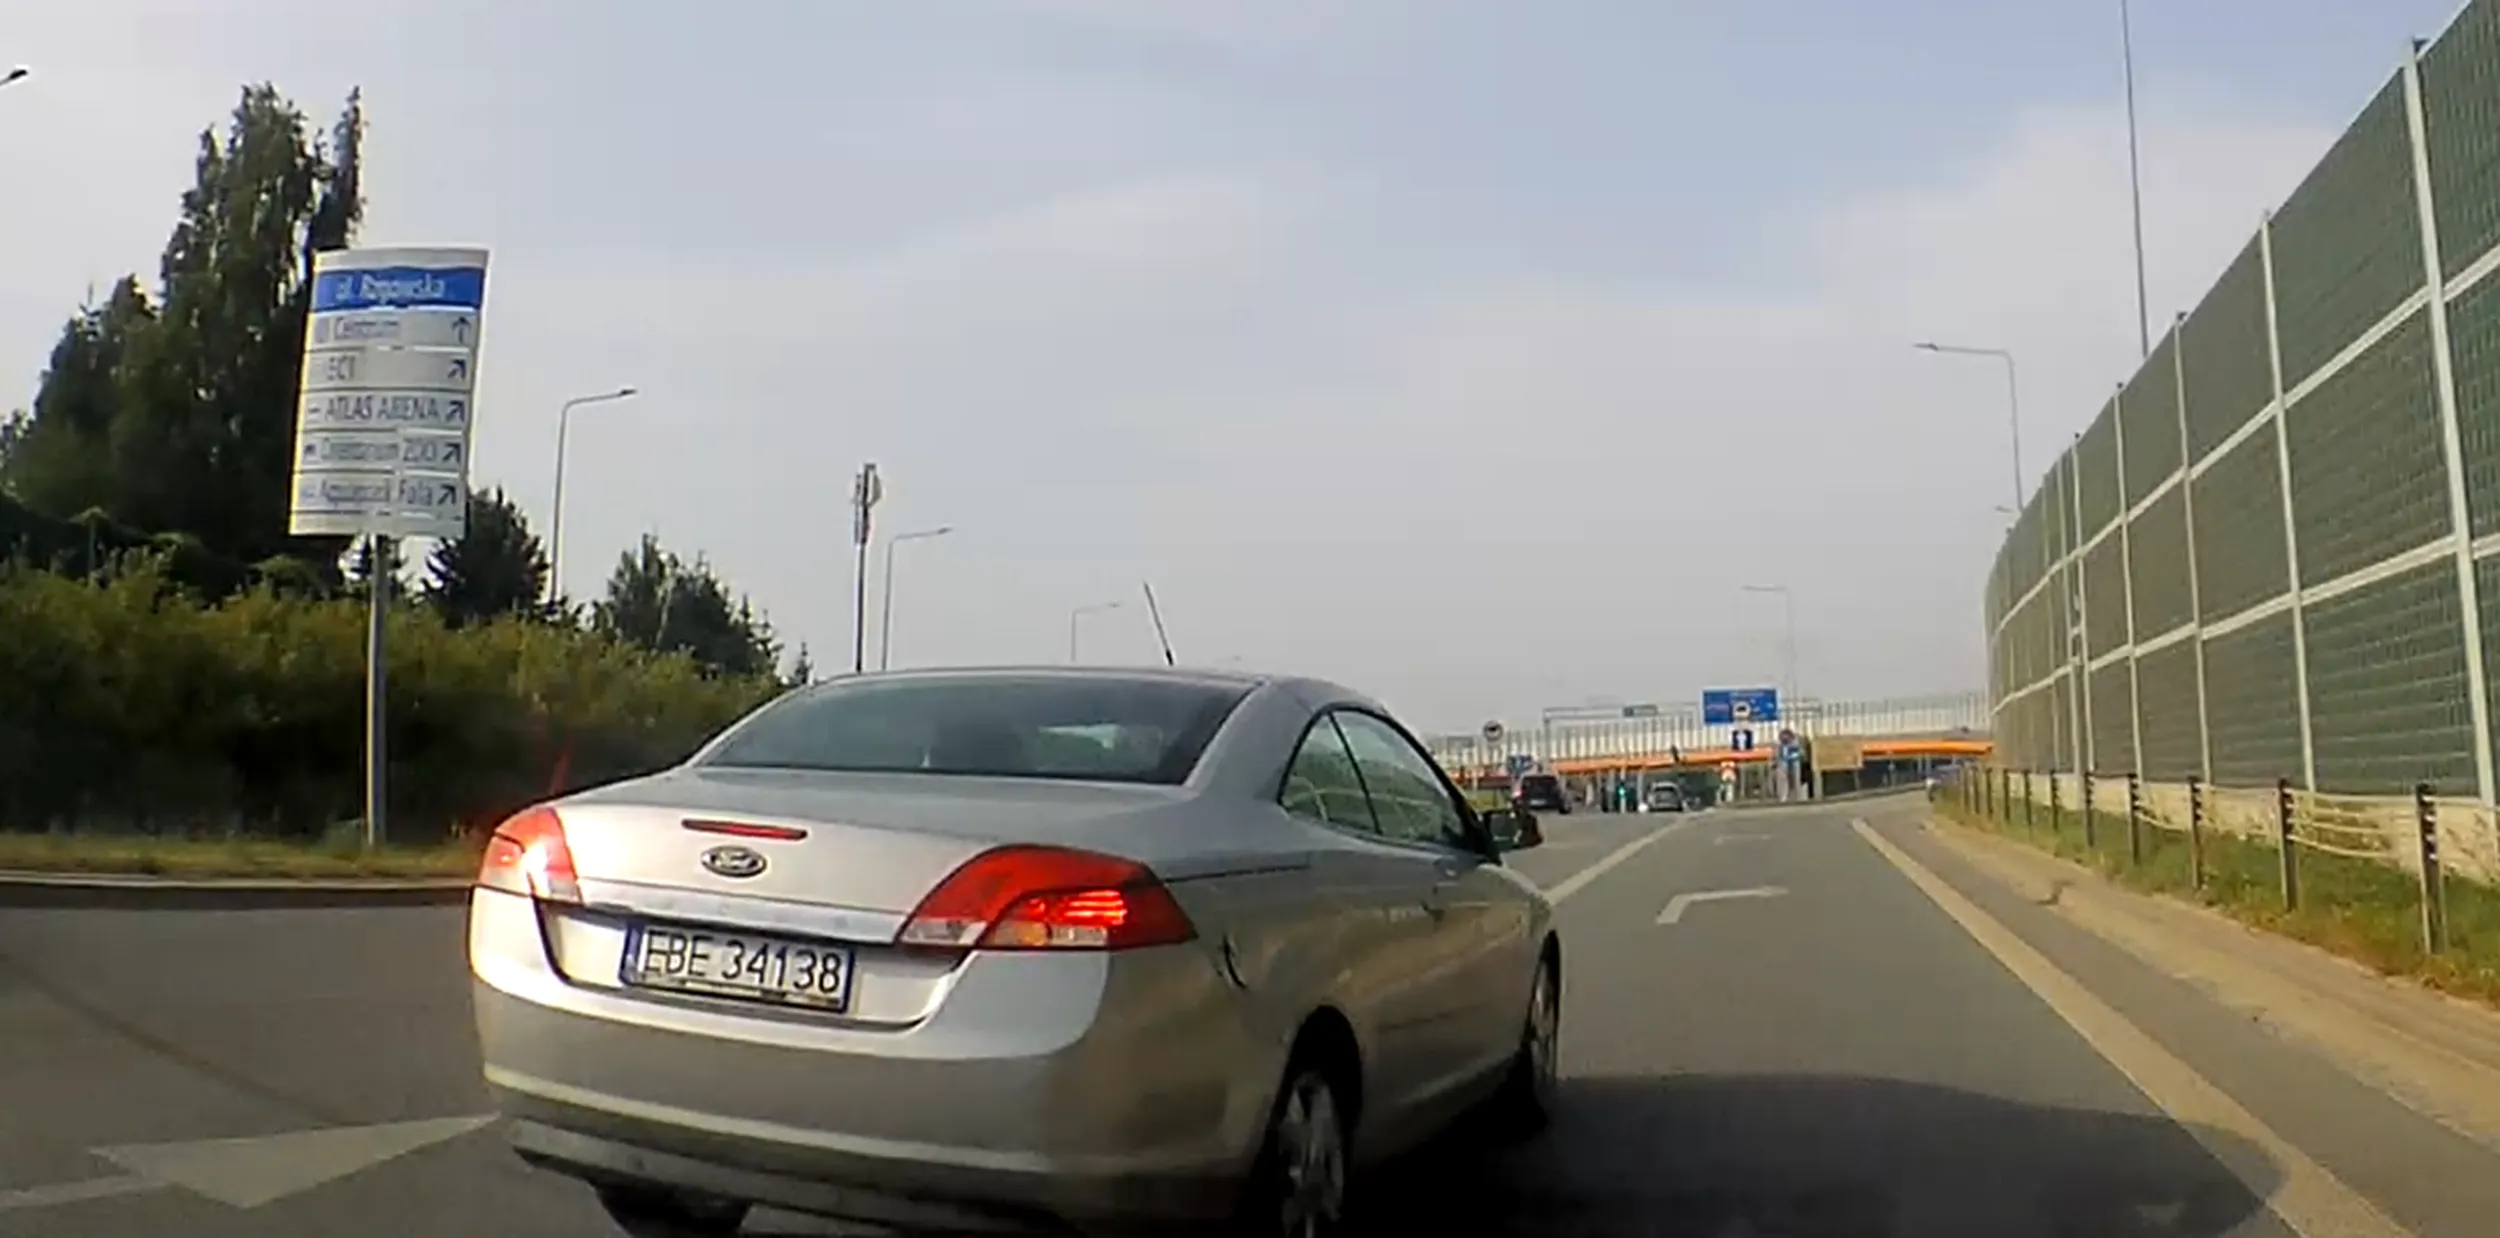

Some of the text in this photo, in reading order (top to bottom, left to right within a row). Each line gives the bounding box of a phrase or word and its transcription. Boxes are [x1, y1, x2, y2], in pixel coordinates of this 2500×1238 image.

[324, 395, 441, 422] ATLAS ARENA
[403, 438, 437, 462] ZOO
[398, 478, 434, 505] Fala
[644, 929, 713, 977] EBE
[722, 939, 843, 993] 34138
